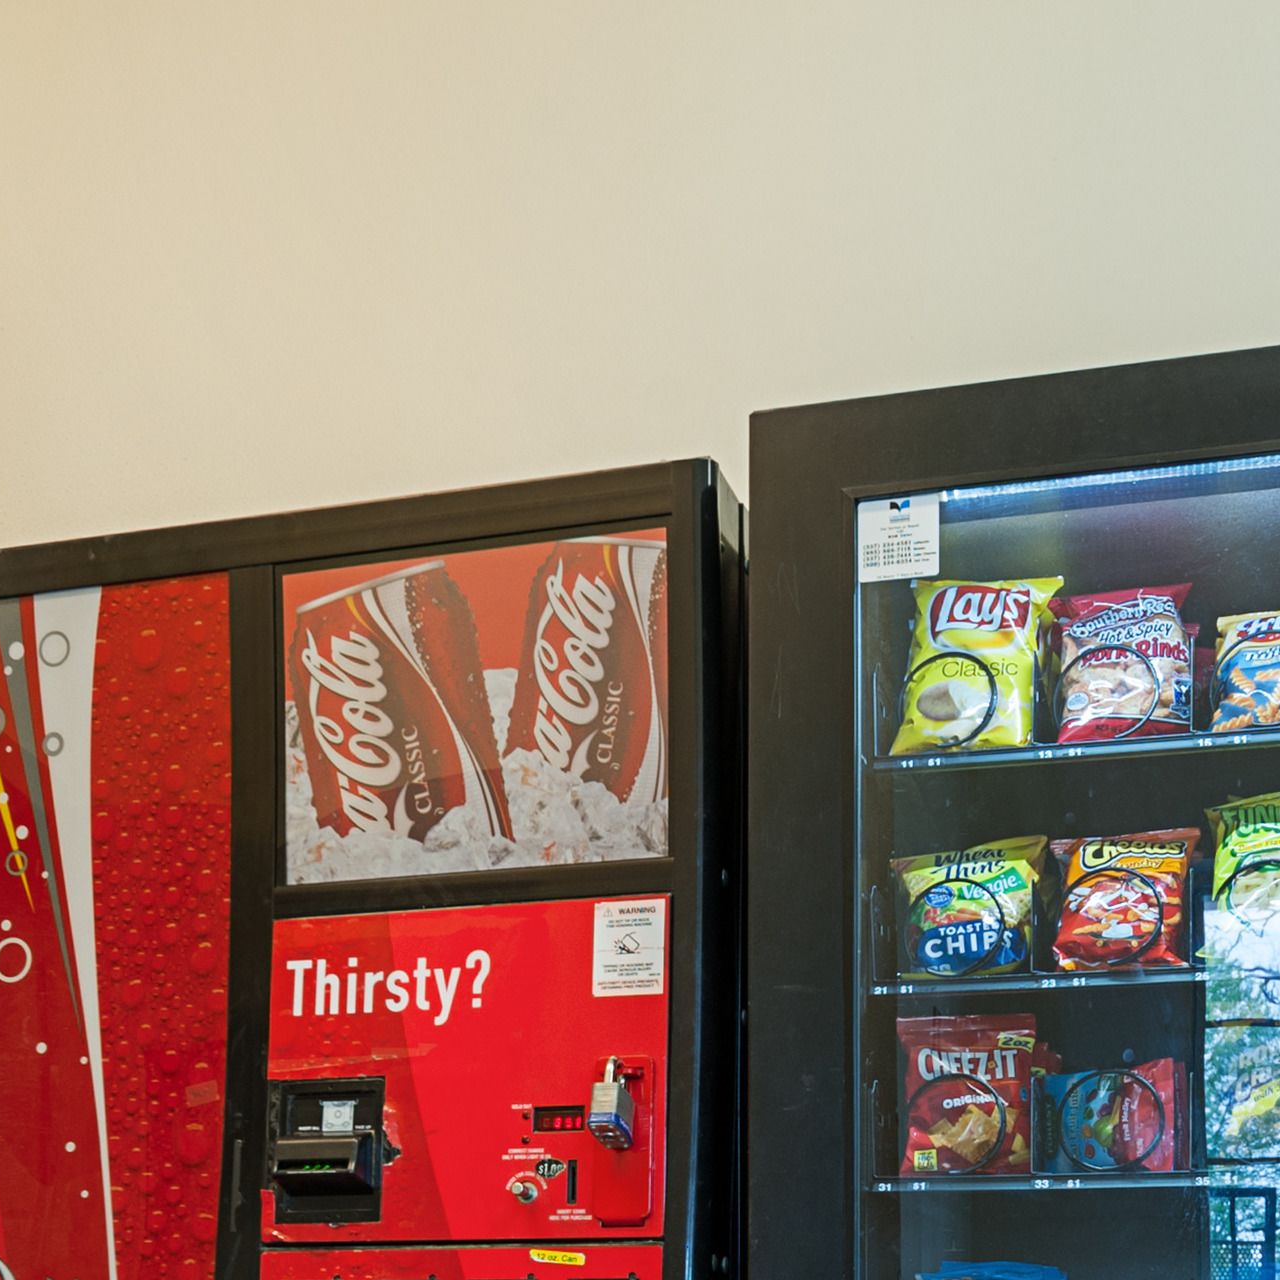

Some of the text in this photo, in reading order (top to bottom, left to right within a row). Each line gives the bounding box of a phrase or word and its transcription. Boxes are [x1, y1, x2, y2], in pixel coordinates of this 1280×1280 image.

[935, 585, 1031, 633] Lay's
[1099, 627, 1122, 645] Hot
[1137, 621, 1173, 644] Spicy
[1135, 638, 1189, 665] Rinds
[941, 658, 1019, 678] Classic
[934, 848, 1007, 868] Wheat
[1080, 839, 1188, 871] Cheetos
[930, 859, 1007, 881] Thins
[961, 874, 1018, 900] Veggie
[618, 906, 656, 915] WARNING
[924, 929, 1014, 959] CHIPS
[286, 949, 491, 1026] Thirsty?
